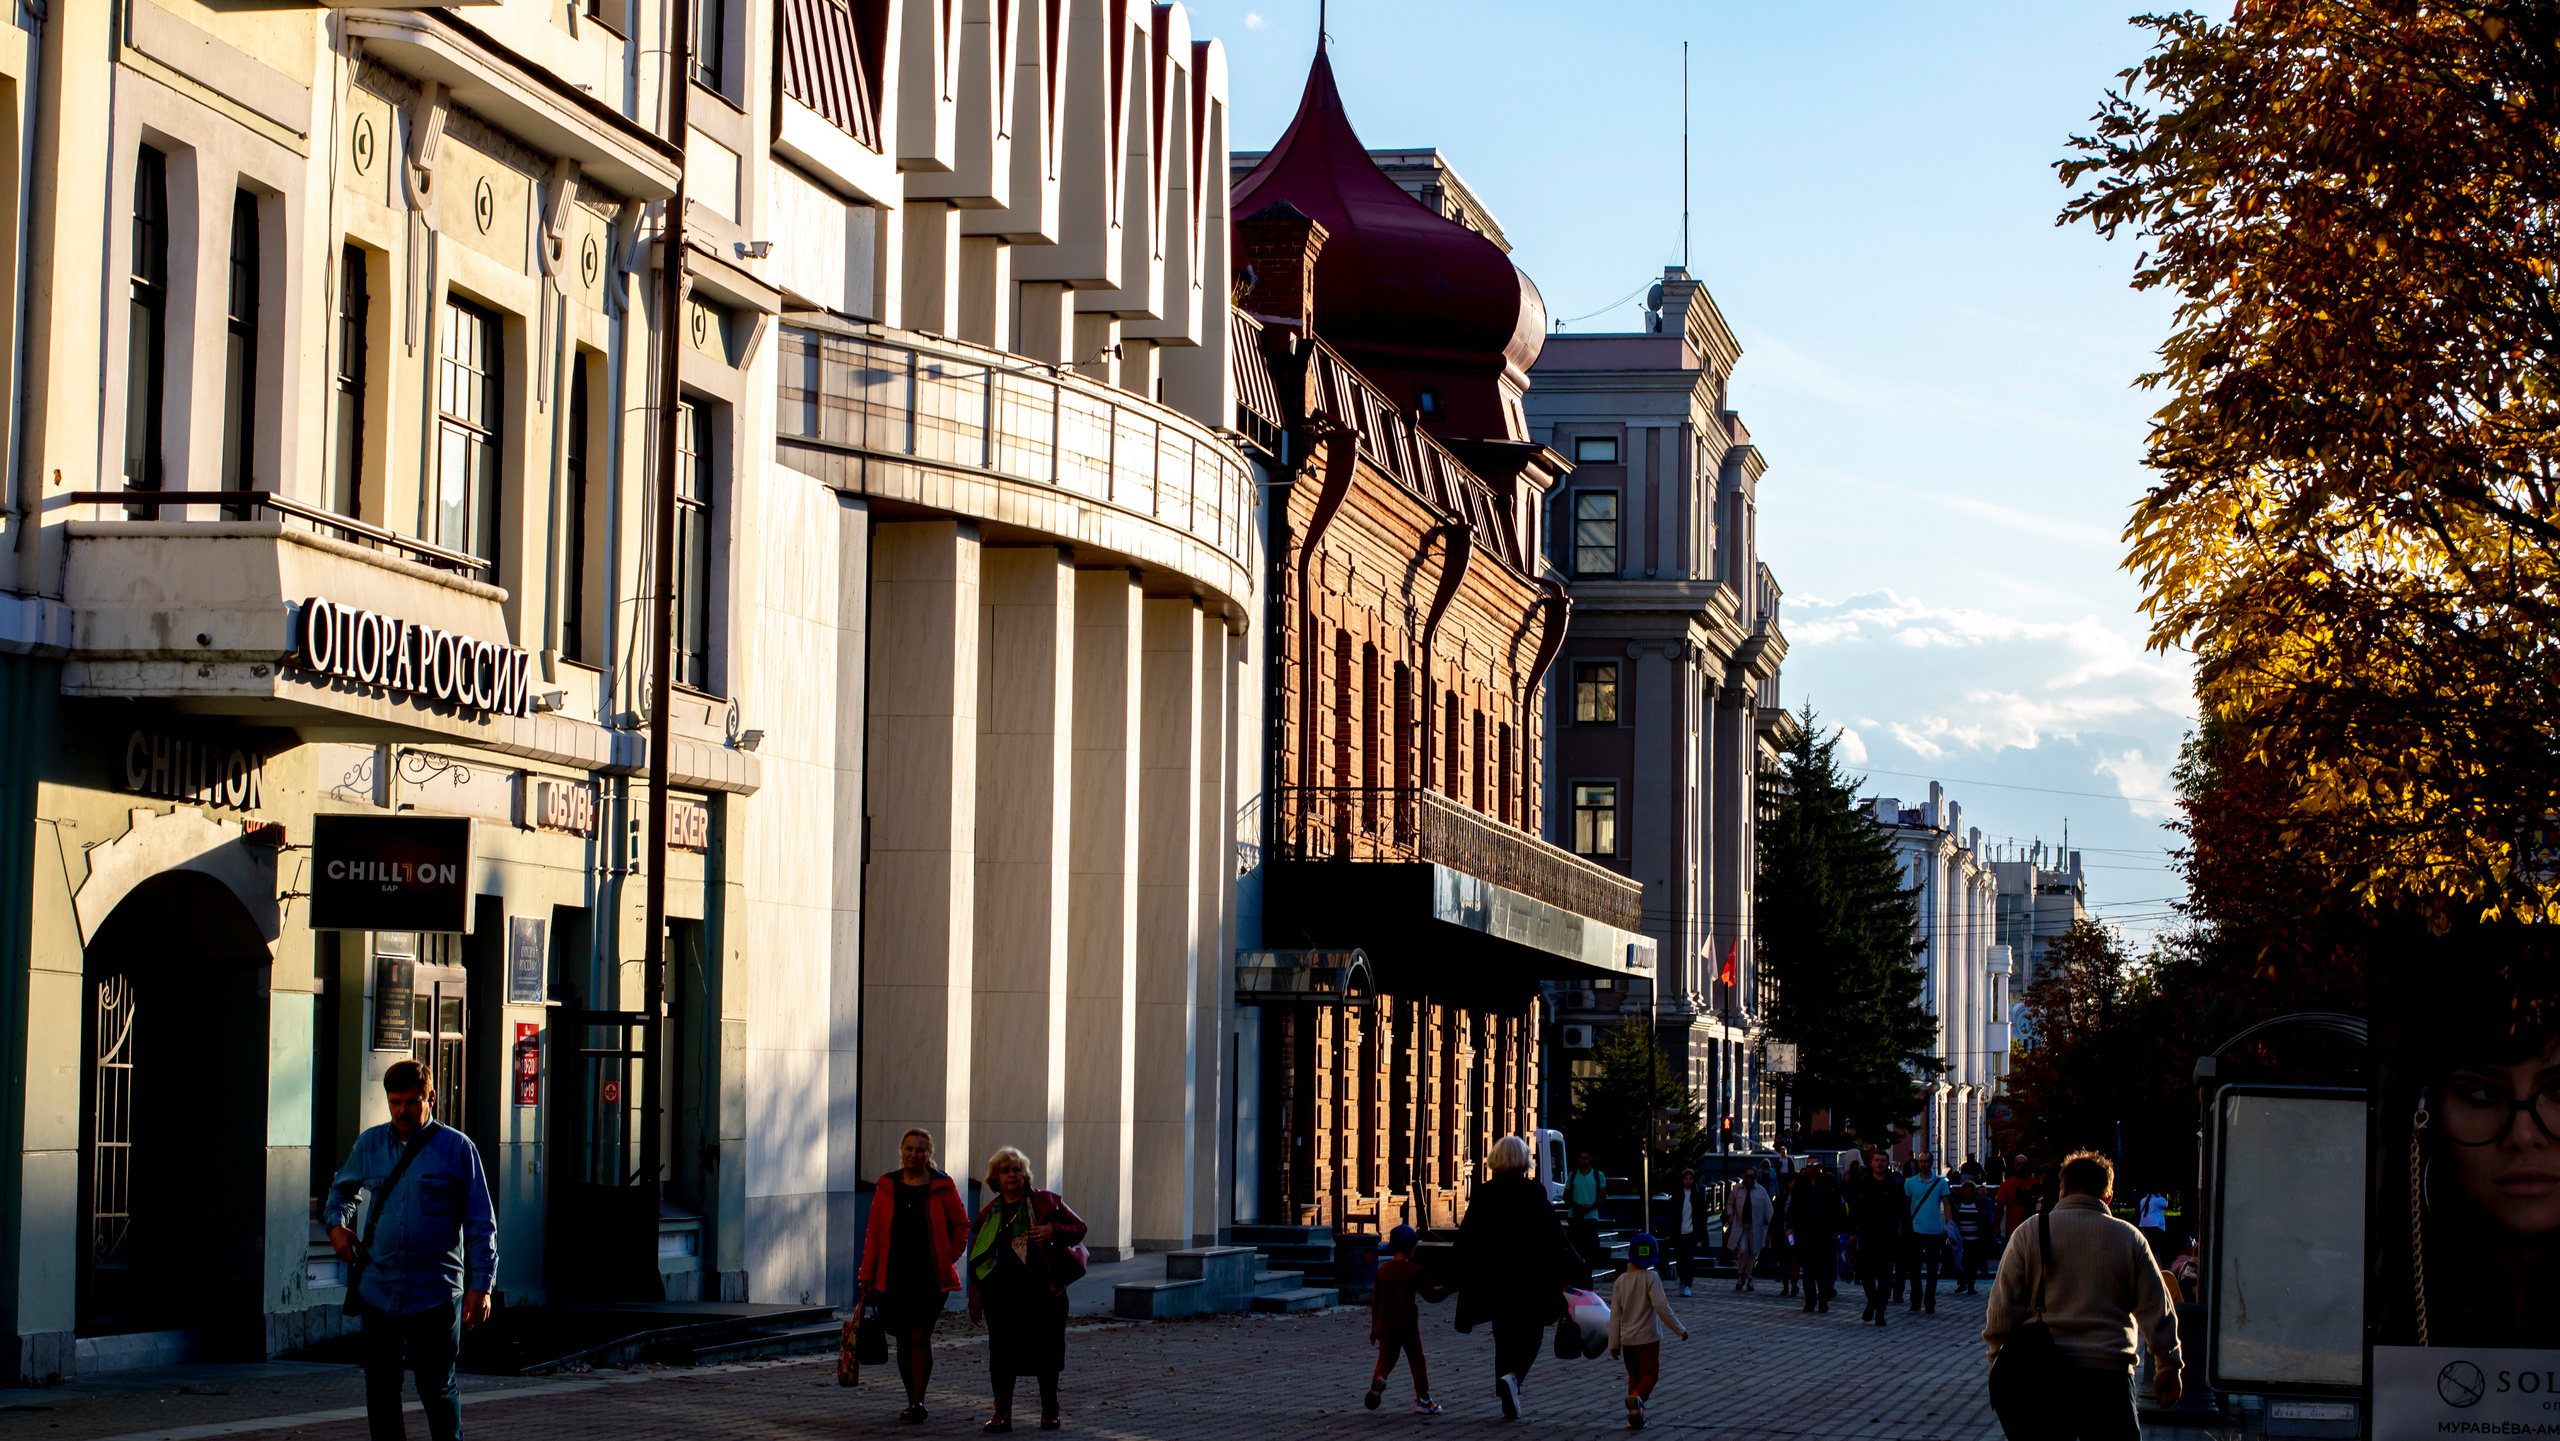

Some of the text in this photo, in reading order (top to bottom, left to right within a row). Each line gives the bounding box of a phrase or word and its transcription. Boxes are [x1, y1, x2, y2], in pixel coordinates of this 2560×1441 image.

[308, 596, 532, 718] ОПОРА РОССИИ
[547, 781, 595, 831] ОБУВЬ
[381, 884, 398, 892] БАР
[2497, 1371, 2560, 1393] SOL
[2438, 1420, 2560, 1436] МУРАВЬЁВА-АМ
